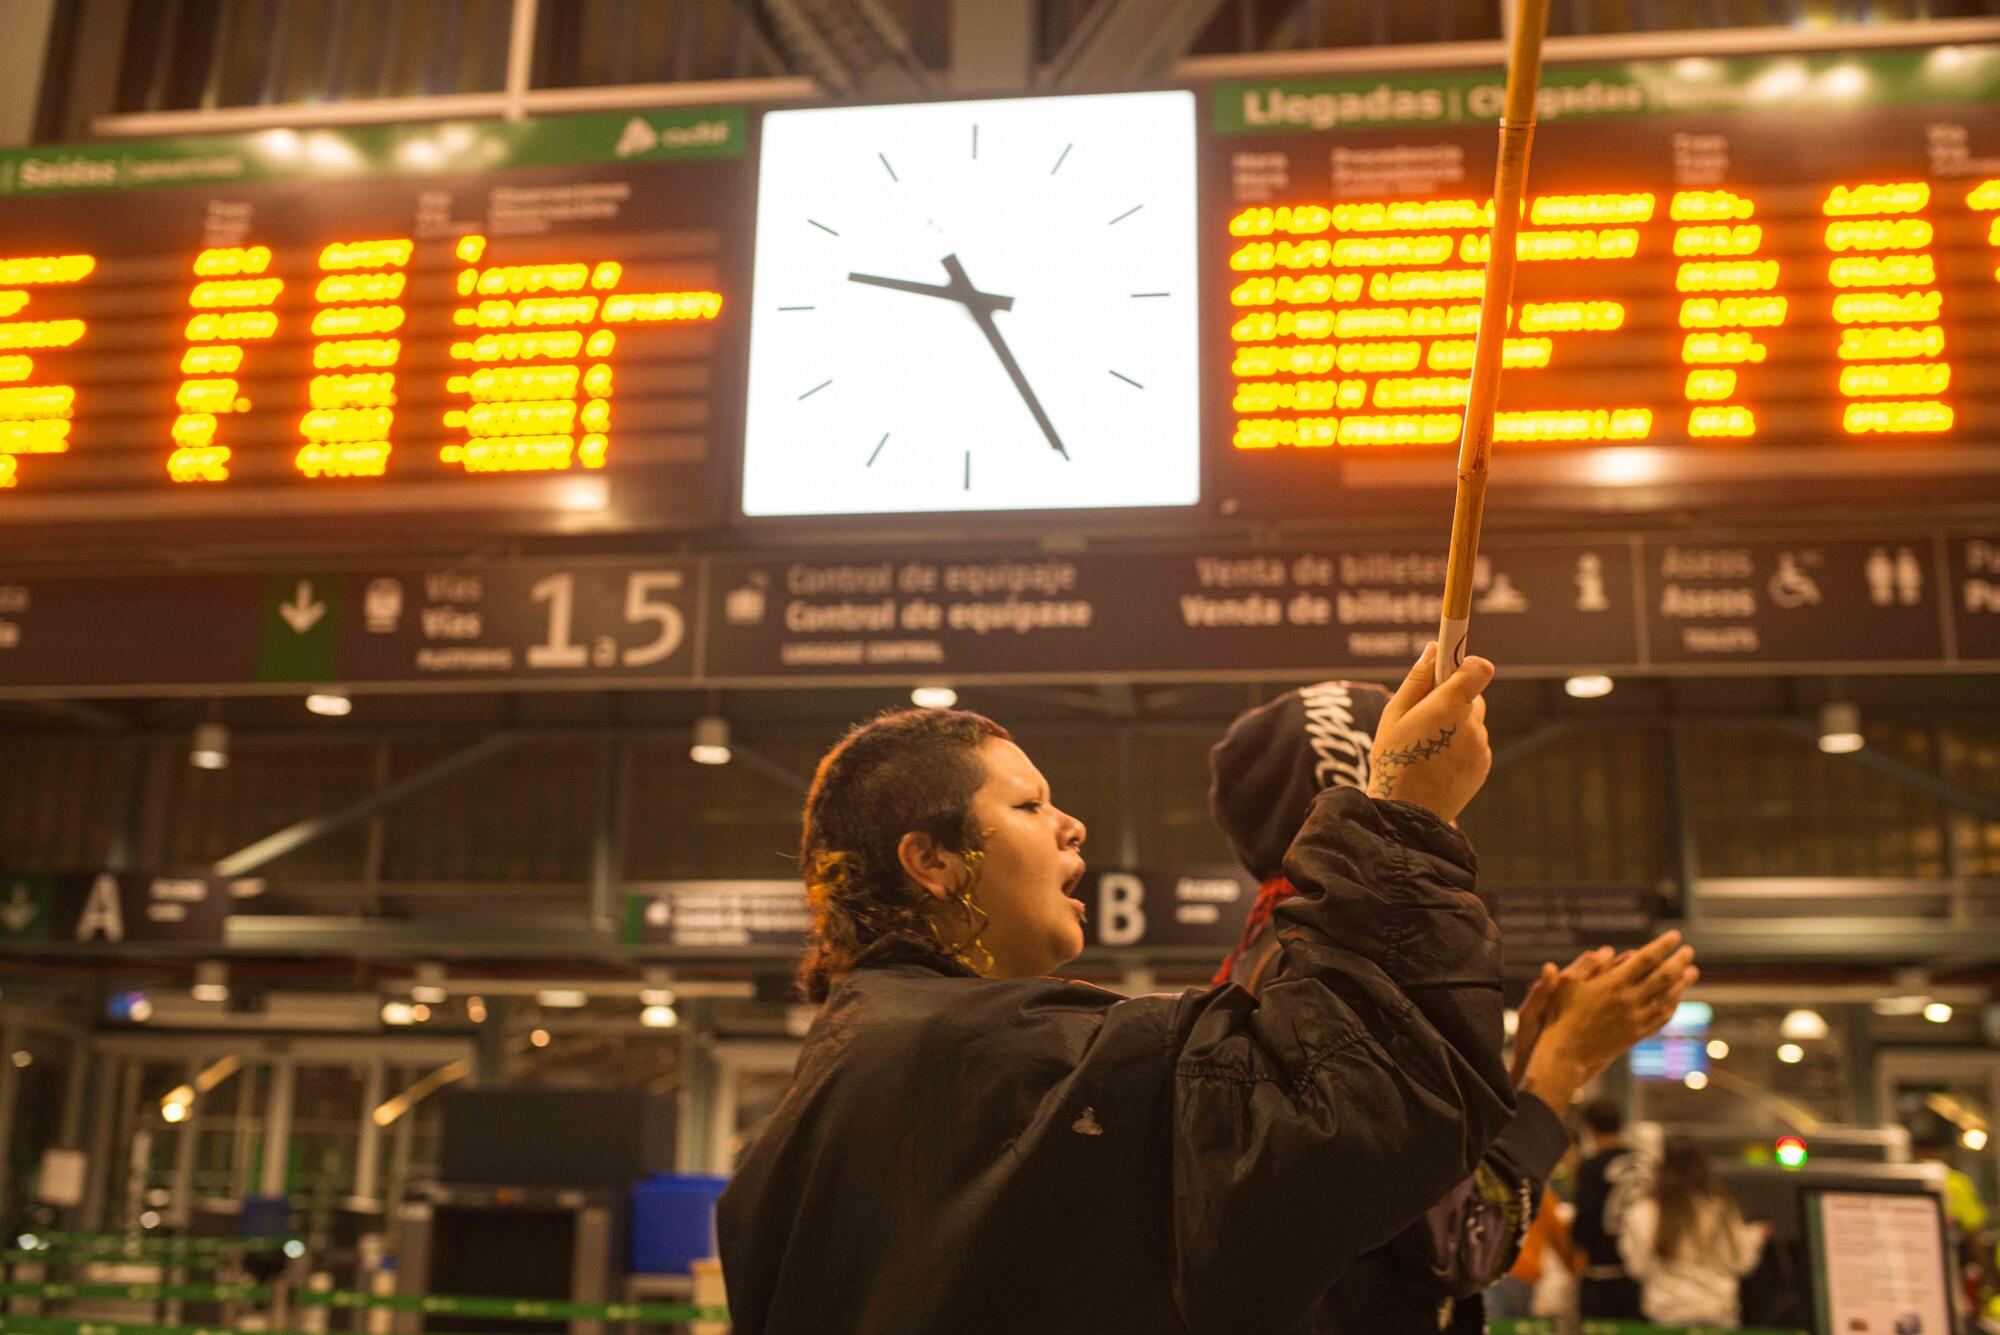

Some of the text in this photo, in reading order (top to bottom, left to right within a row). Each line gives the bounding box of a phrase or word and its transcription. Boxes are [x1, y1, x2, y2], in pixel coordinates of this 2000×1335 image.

[1243, 85, 1443, 130] Llegadas
[898, 562, 938, 593] de
[1293, 554, 1334, 586] de
[526, 571, 590, 668] 1
[622, 570, 684, 667] 5
[786, 600, 896, 633] Control
[901, 599, 943, 631] de
[1287, 592, 1331, 625] de
[1337, 589, 1444, 625] billete
[76, 872, 124, 942] A
[1099, 872, 1146, 945] B
